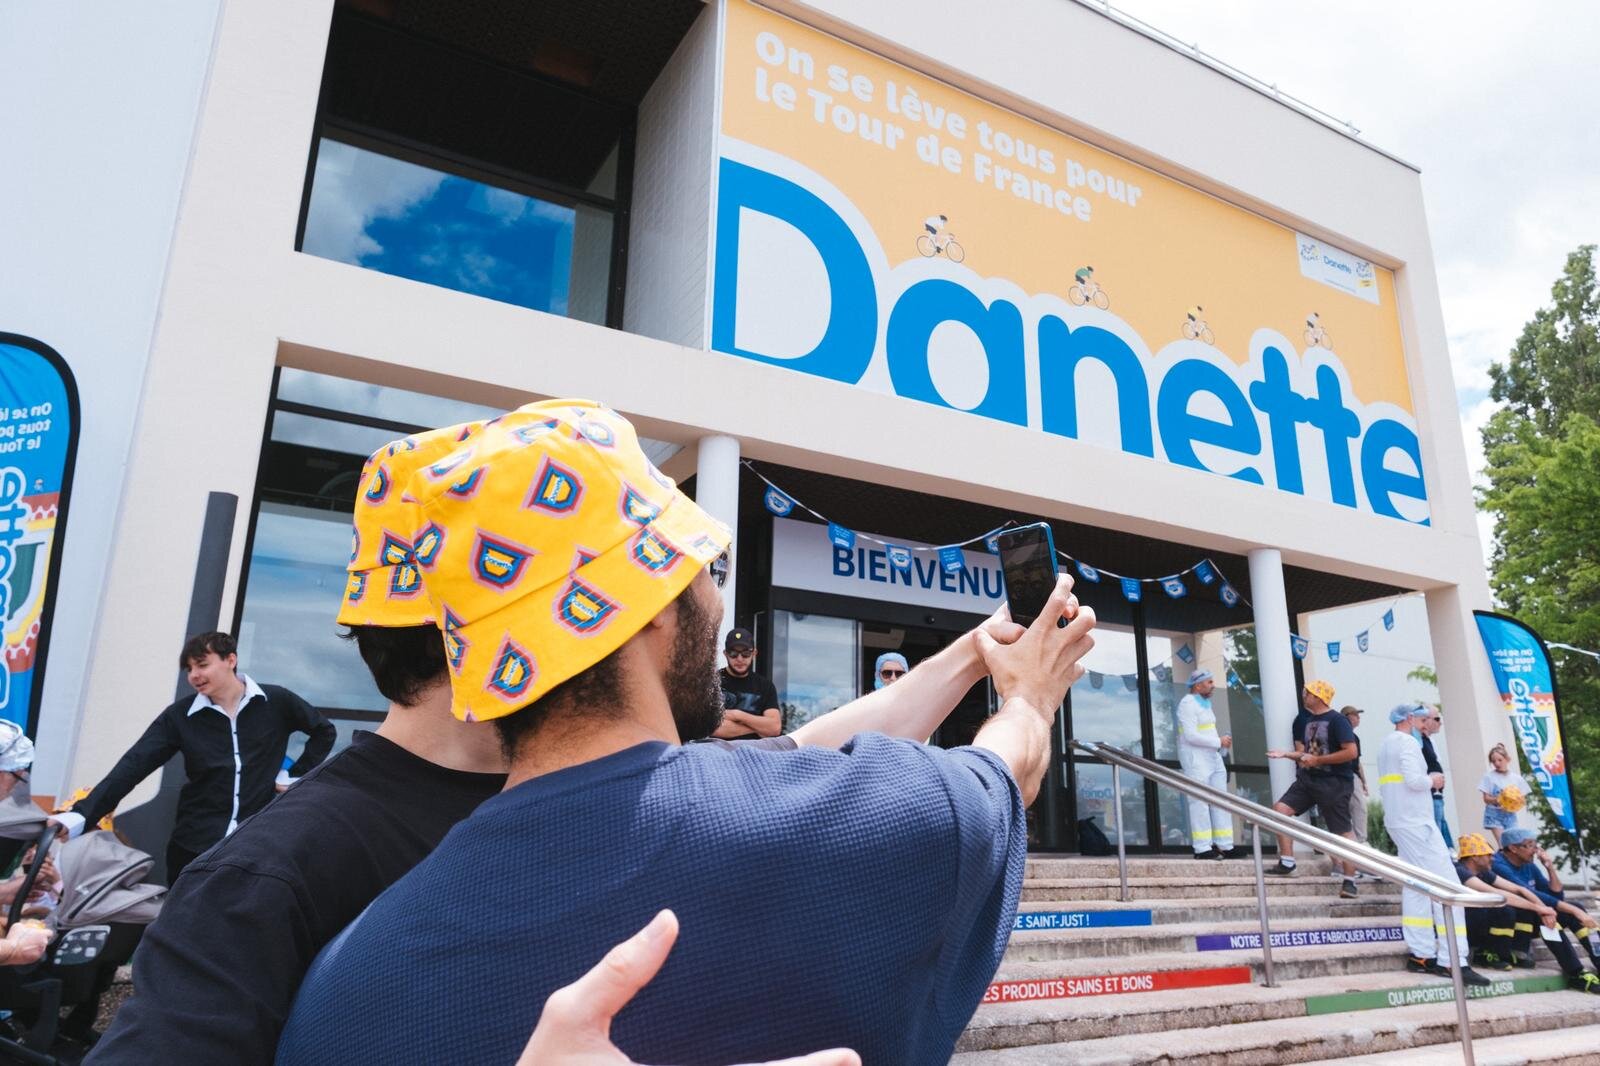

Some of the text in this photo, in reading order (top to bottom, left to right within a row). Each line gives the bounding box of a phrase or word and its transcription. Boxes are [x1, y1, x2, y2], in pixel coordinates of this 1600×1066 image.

[755, 31, 1142, 207] On se lève tous pour
[755, 67, 1092, 223] le Tour de France
[711, 156, 1430, 526] Danette
[833, 543, 1003, 599] BIENVENU
[1025, 914, 1085, 928] SAINT-JUST
[1086, 913, 1090, 926] !
[1230, 935, 1261, 948] NOTRE
[1292, 933, 1308, 945] EST
[1309, 932, 1321, 943] DE
[1321, 930, 1365, 943] FABRIQUER
[1366, 929, 1387, 941] POUR
[1388, 928, 1402, 940] LES
[984, 975, 1153, 1001] ES PRODUITS SAINS ET BONS
[1388, 991, 1405, 1006] QUI
[1406, 987, 1455, 1003] APPORTENT
[1486, 981, 1515, 995] PLAISIR
